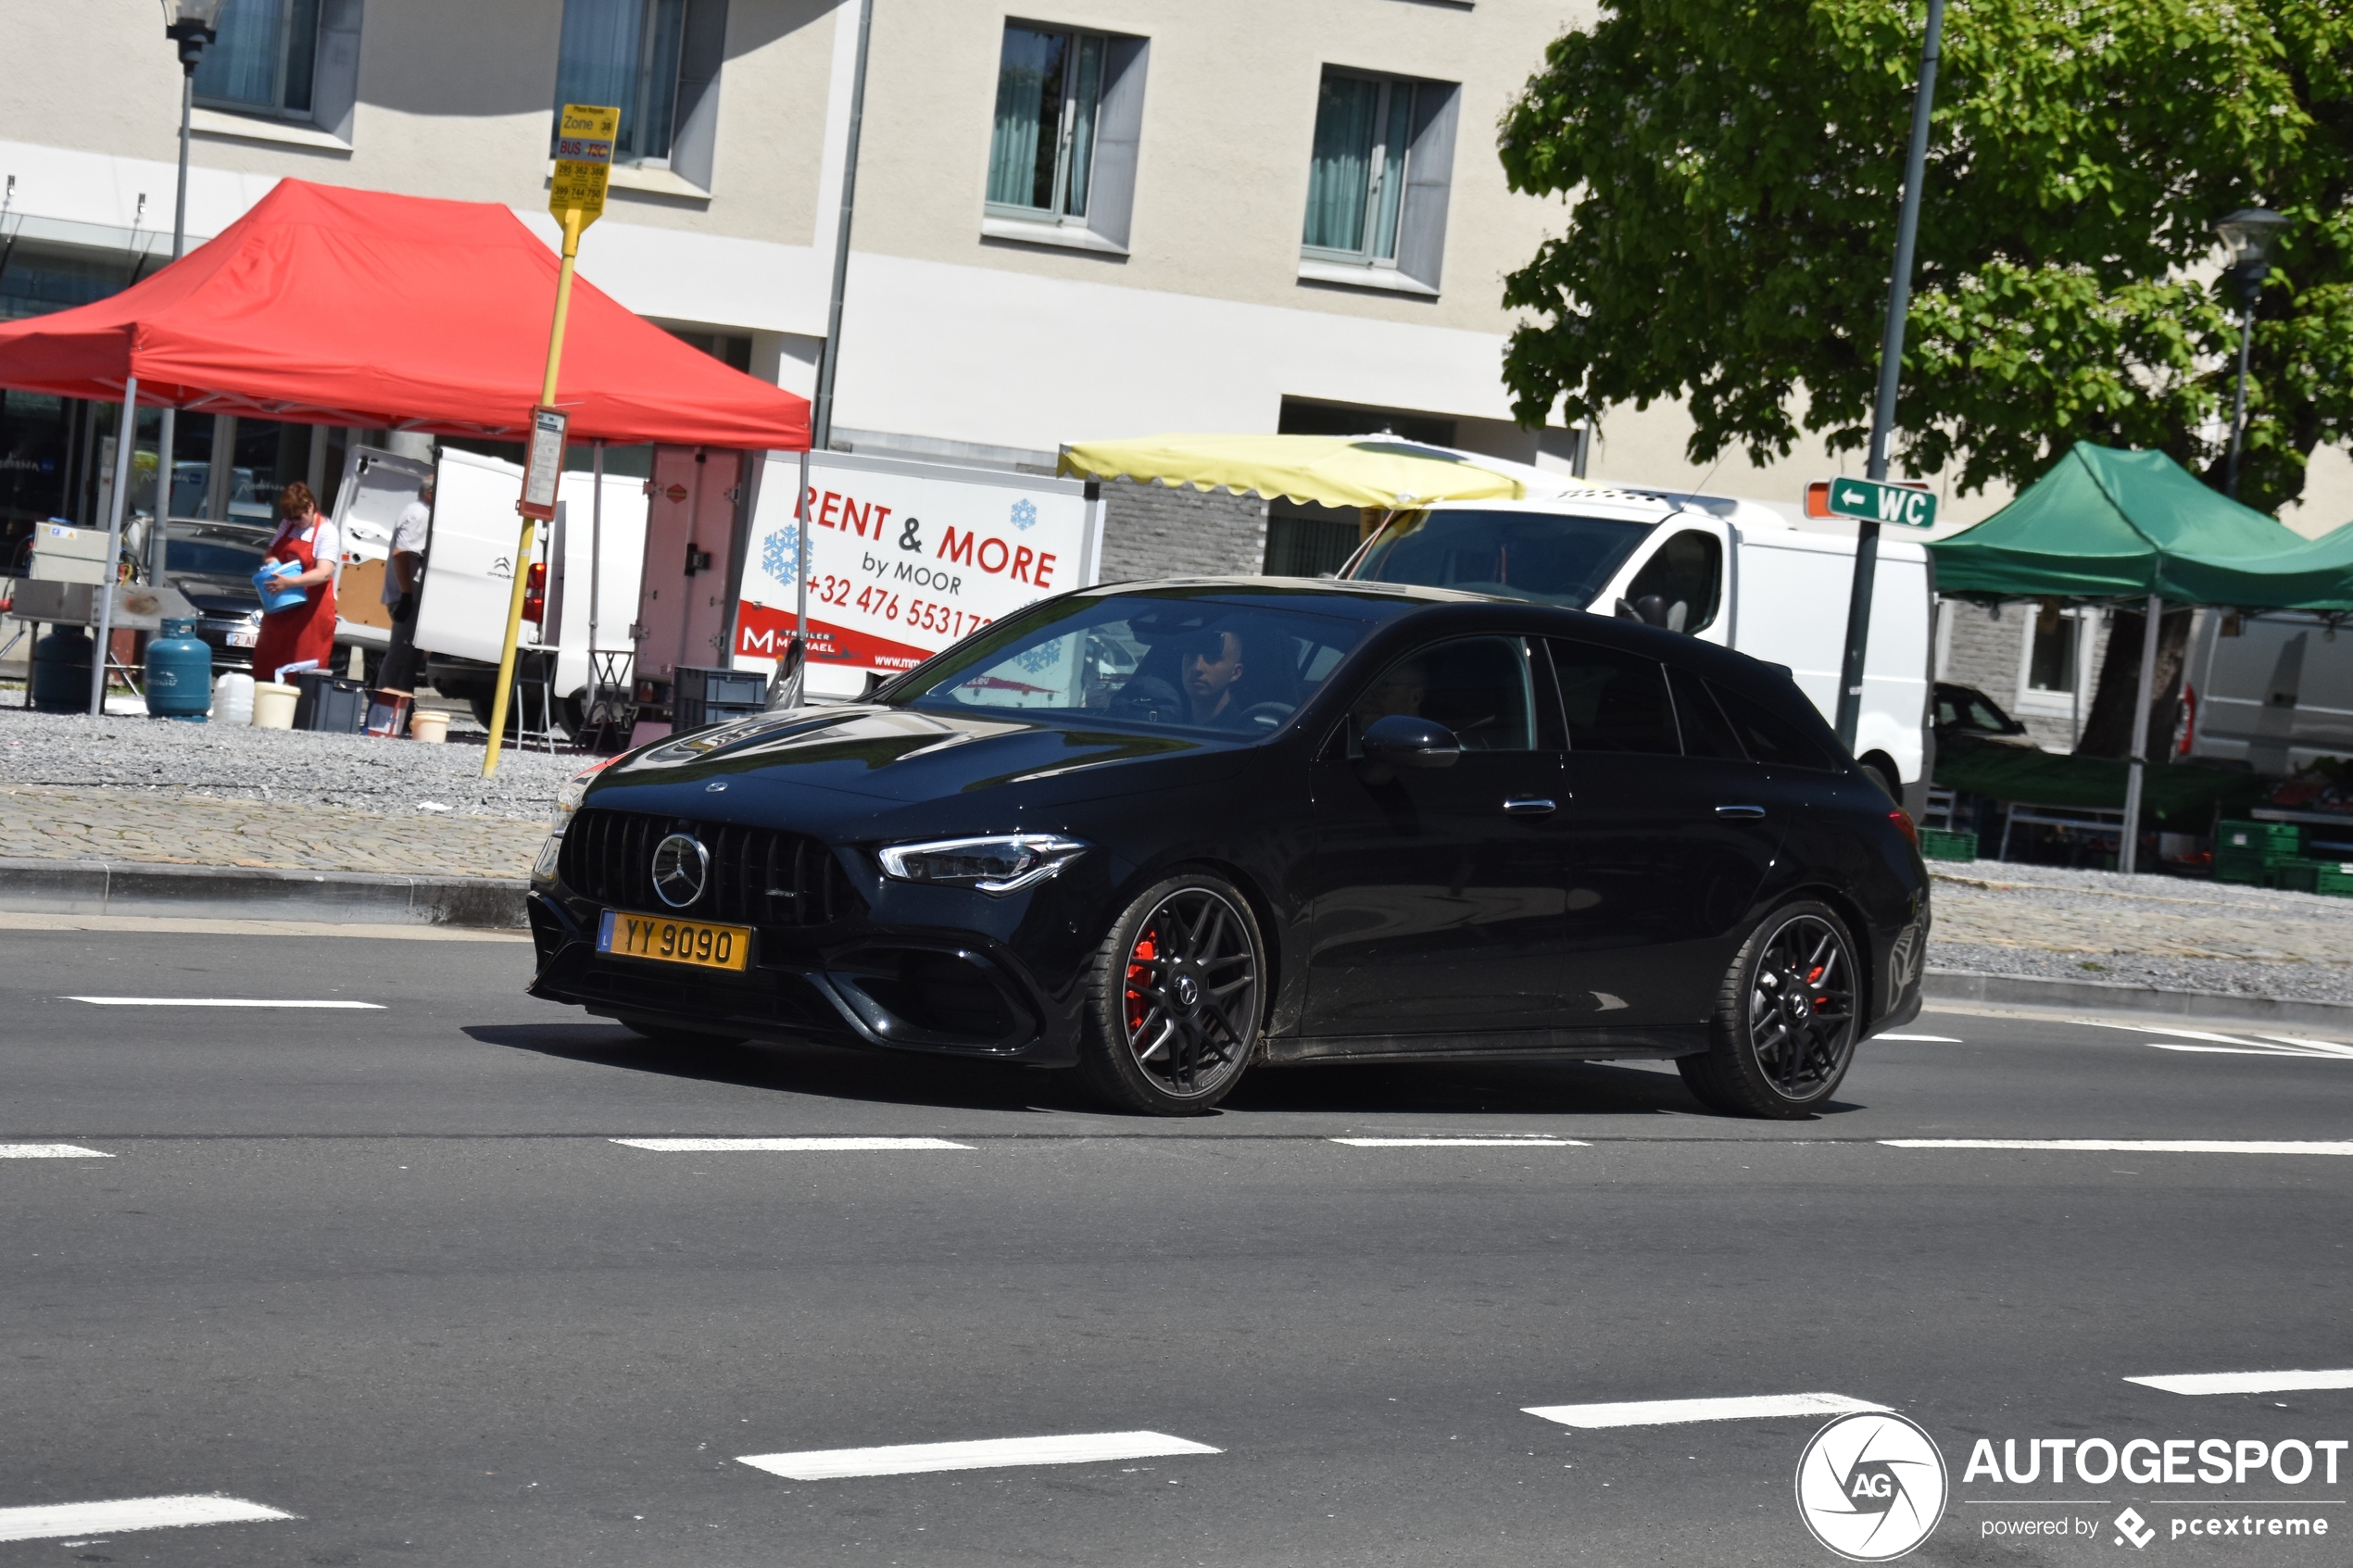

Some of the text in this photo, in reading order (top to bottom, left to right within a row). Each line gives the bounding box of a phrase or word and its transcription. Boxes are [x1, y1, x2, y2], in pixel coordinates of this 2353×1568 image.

[563, 115, 611, 132] Zone 38
[560, 140, 608, 157] BUS TEC
[572, 188, 585, 197] 744
[586, 189, 601, 198] 750
[1878, 486, 1927, 526] WC
[794, 485, 1057, 589] RENT & MORE
[862, 551, 962, 596] by MOOR
[806, 574, 851, 608] +32
[856, 585, 900, 621] 476
[742, 626, 774, 654] M
[602, 935, 608, 946] L
[626, 918, 733, 963] YY 9090
